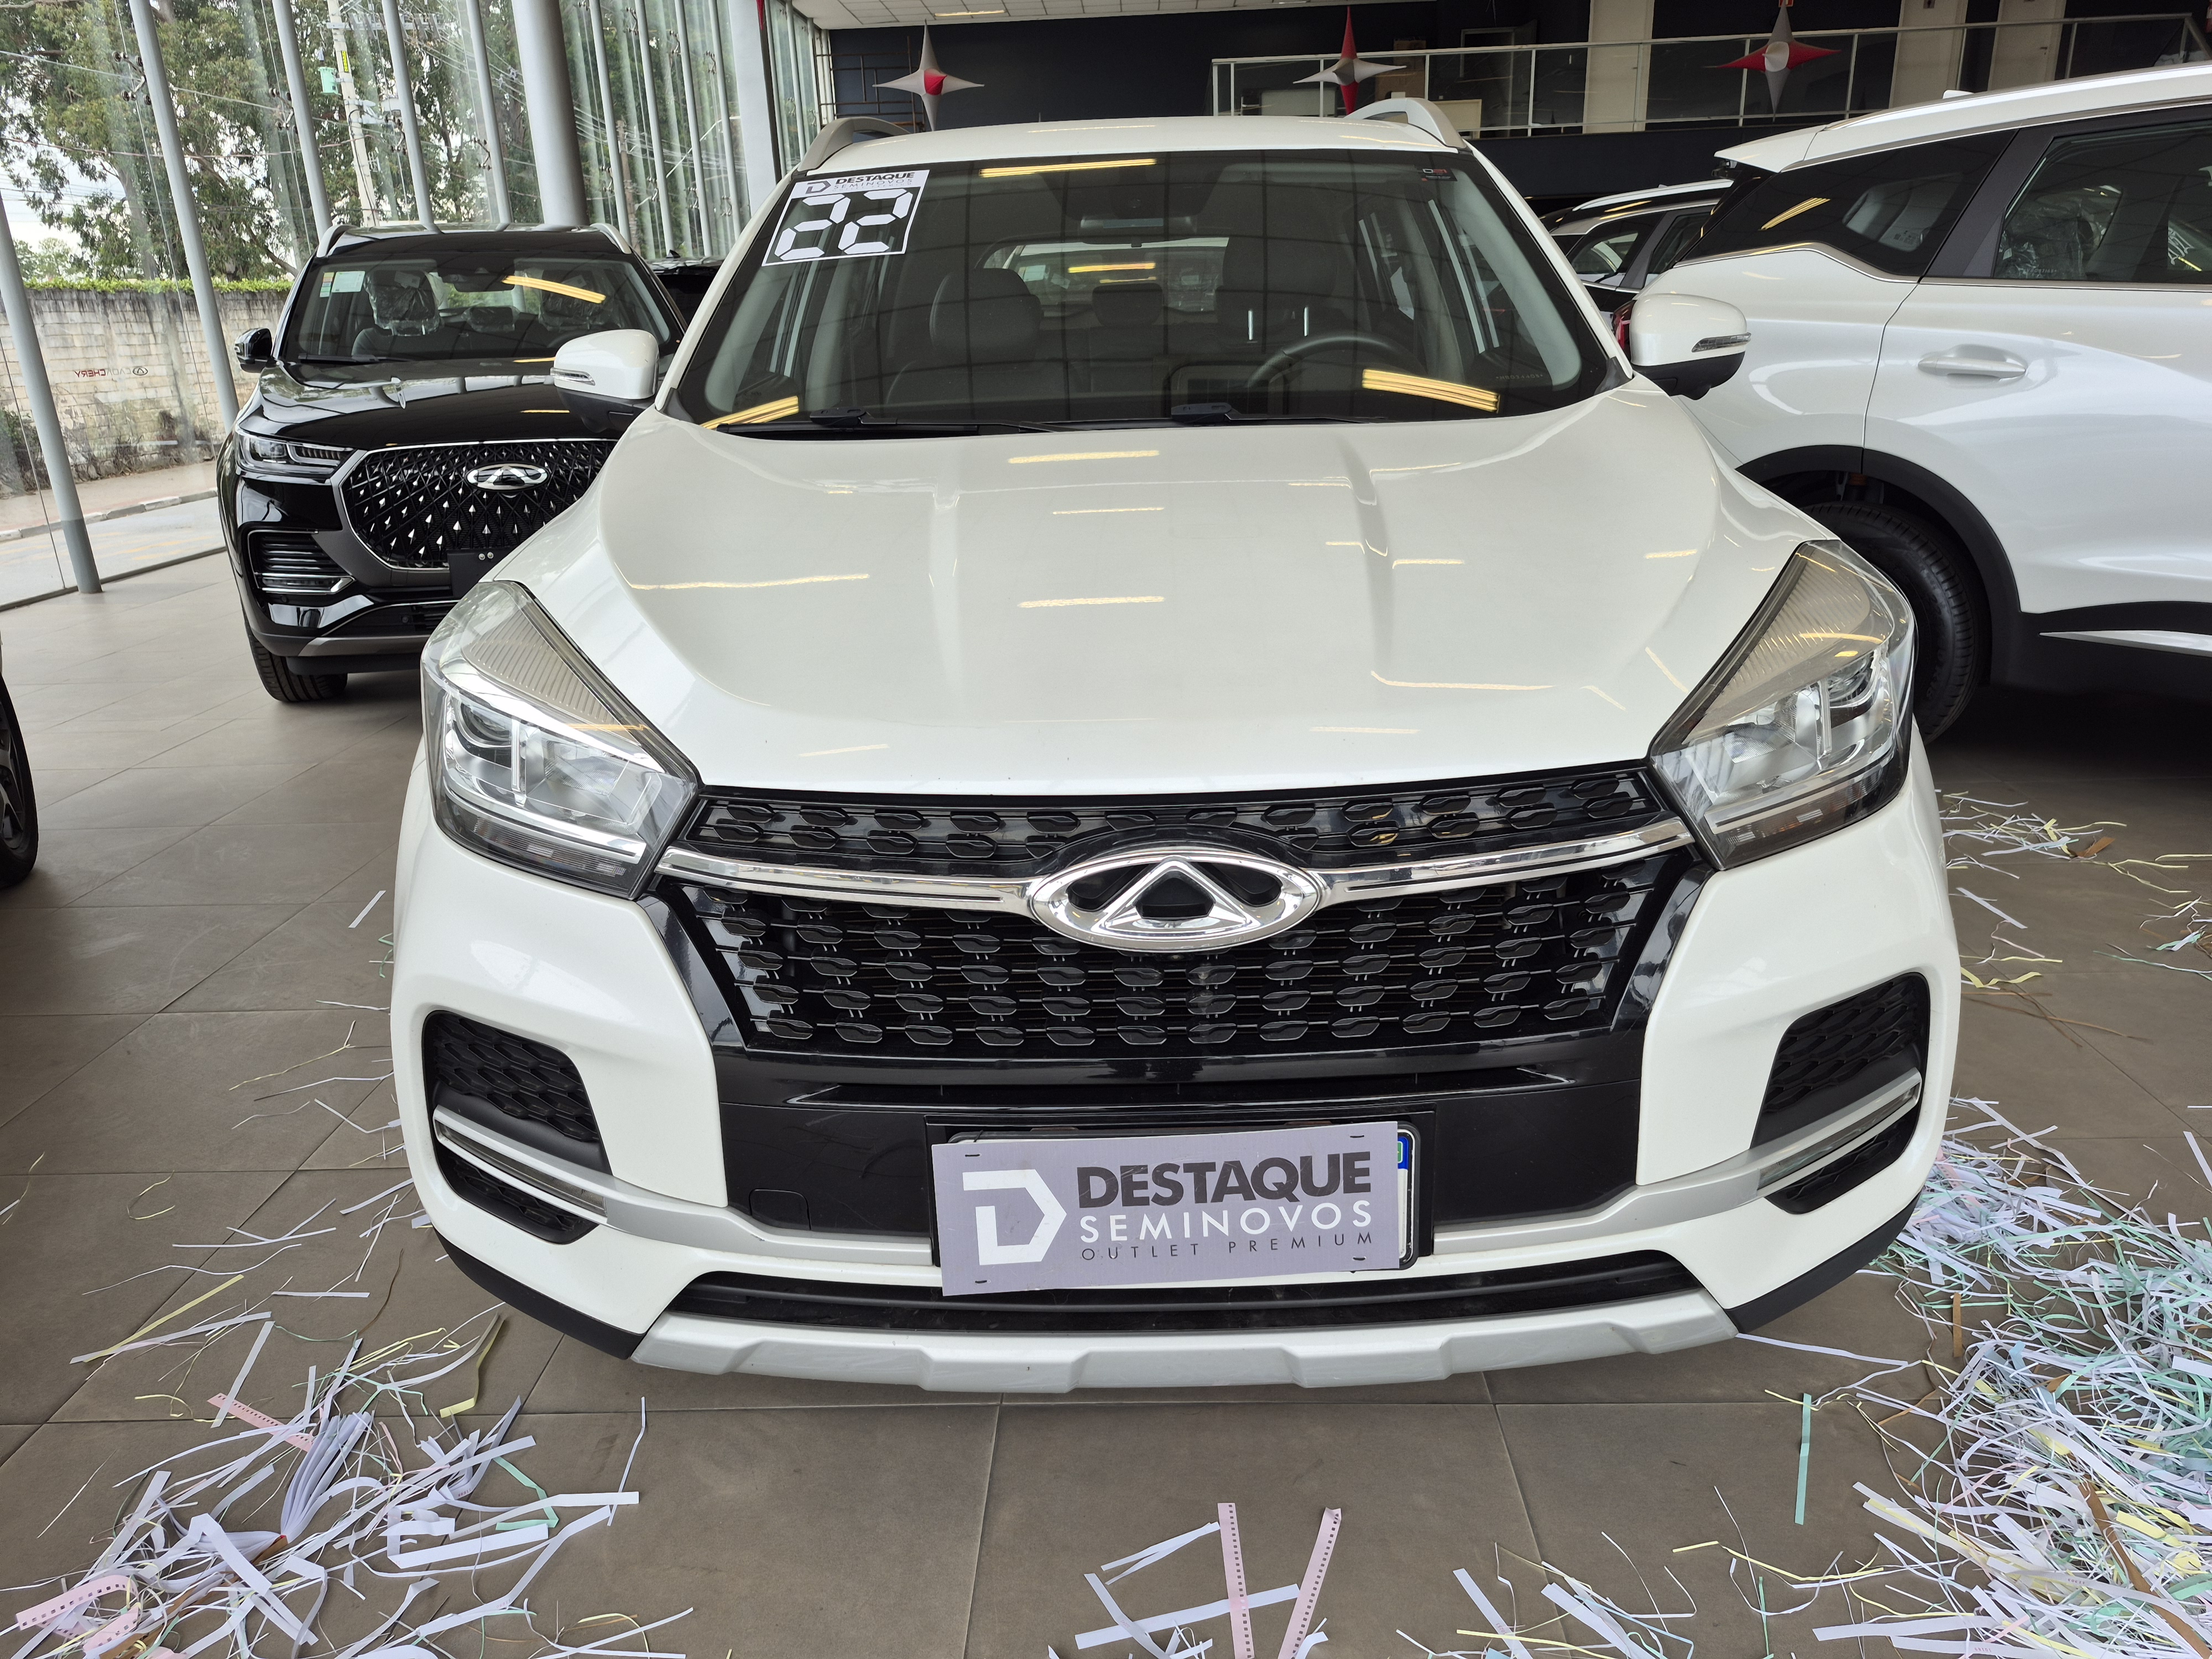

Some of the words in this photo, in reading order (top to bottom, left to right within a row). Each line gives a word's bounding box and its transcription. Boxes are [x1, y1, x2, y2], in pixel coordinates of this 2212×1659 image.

[833, 178, 912, 189] SEMINOVOS
[836, 172, 915, 184] DESTAQUE
[775, 188, 913, 261] 22
[1077, 1151, 1371, 1208] DESTAQUE
[1079, 1199, 1371, 1243] SEMINOVOS
[1082, 1244, 1199, 1260] OUTLET
[1228, 1232, 1372, 1254] PREMIUM
